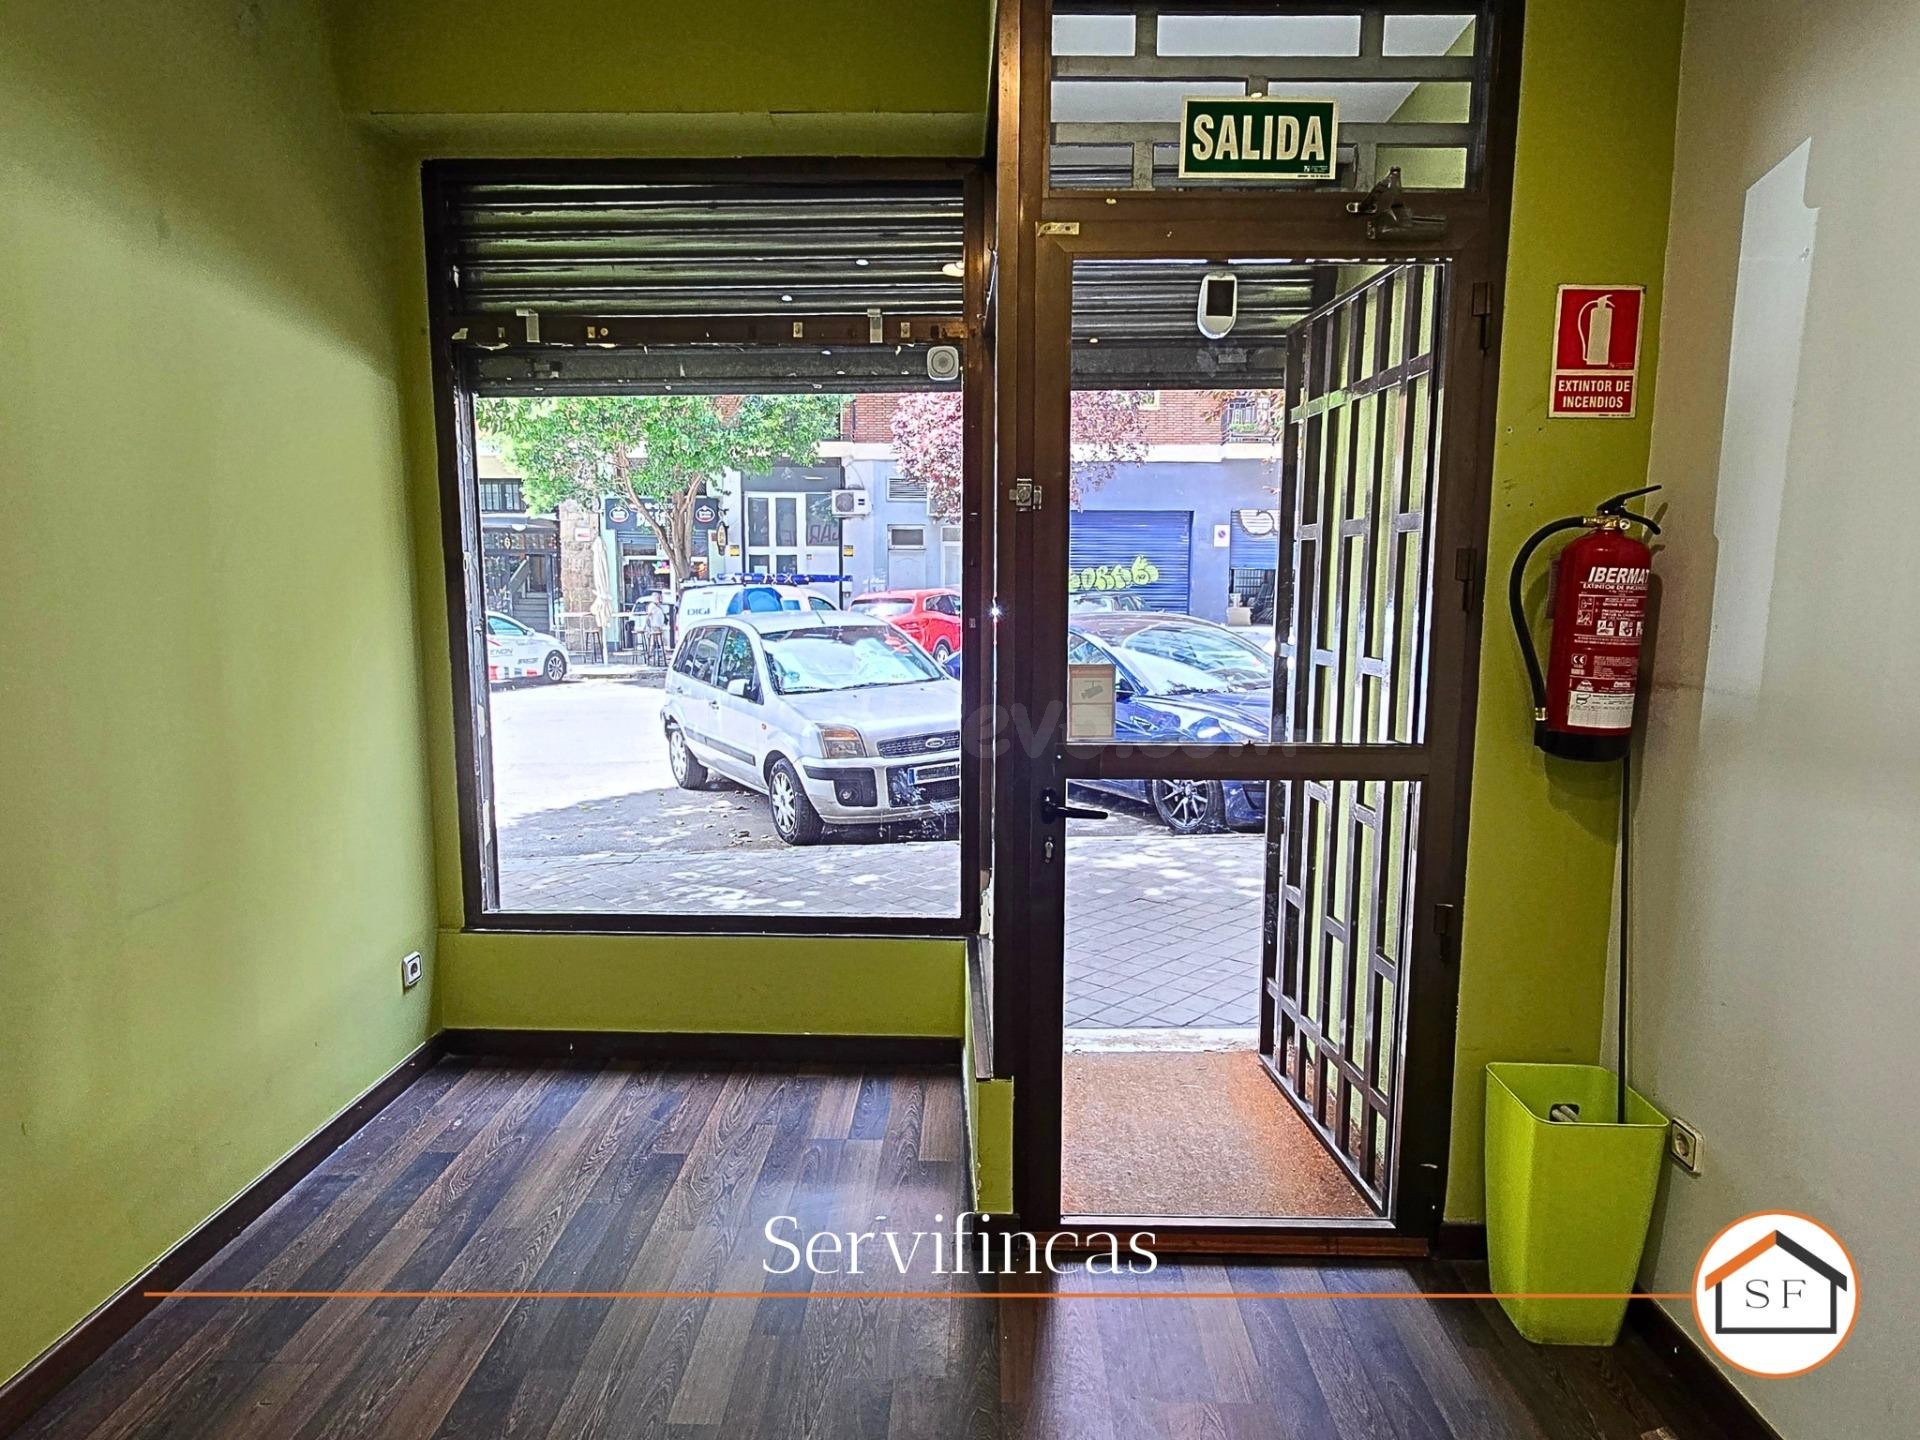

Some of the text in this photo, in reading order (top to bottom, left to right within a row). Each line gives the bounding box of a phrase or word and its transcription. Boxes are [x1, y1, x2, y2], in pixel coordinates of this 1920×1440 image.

[1192, 113, 1325, 161] SALIDA
[1558, 380, 1631, 392] EXTINTOR DE
[1562, 396, 1623, 408] INCENDIOS
